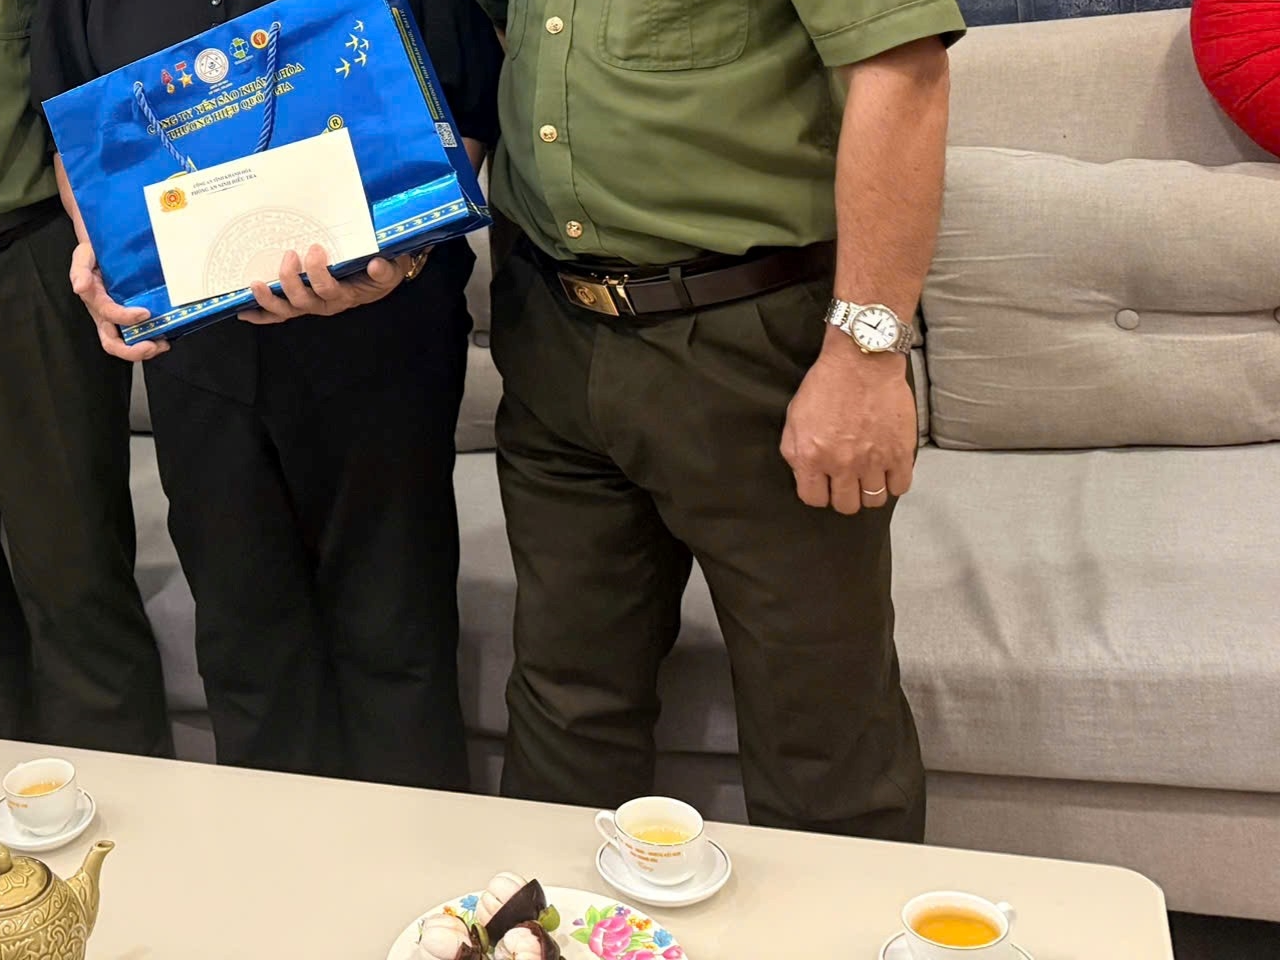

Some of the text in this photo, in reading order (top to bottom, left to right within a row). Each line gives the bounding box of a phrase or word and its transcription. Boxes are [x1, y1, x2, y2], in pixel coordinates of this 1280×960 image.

[147, 114, 178, 135] CNG
[177, 108, 193, 121] TY
[193, 98, 217, 115] YẾN
[217, 90, 239, 106] SÀO
[279, 62, 305, 81] HÒA
[167, 81, 294, 140] THƯƠNG HIỆU QUỐ GIA
